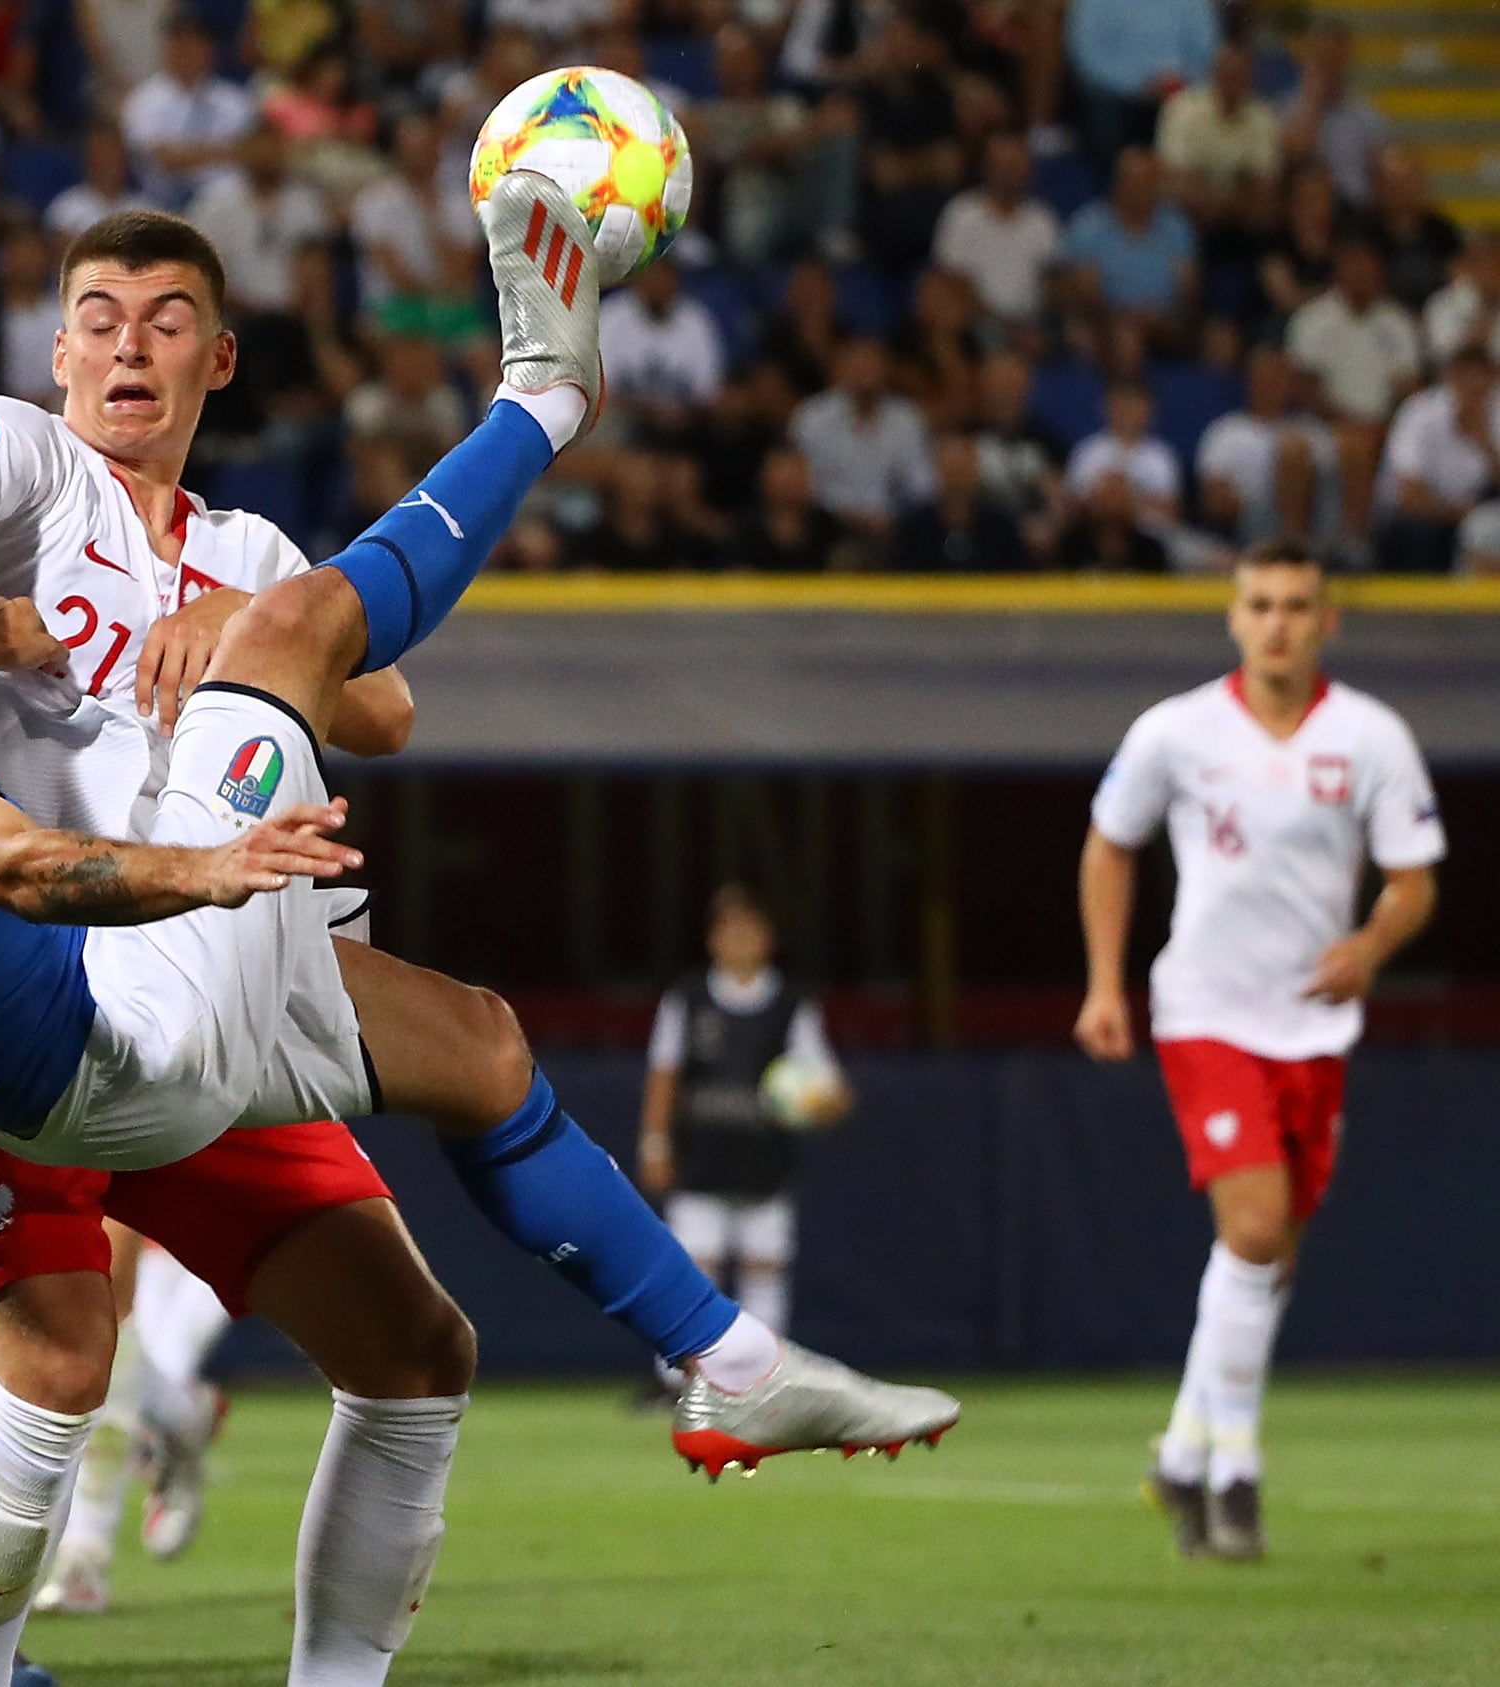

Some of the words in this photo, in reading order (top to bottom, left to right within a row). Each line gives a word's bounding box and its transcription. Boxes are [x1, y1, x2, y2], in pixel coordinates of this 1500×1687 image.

[55, 594, 132, 697] 21
[220, 782, 266, 814] ITALIA
[1202, 801, 1248, 861] 16
